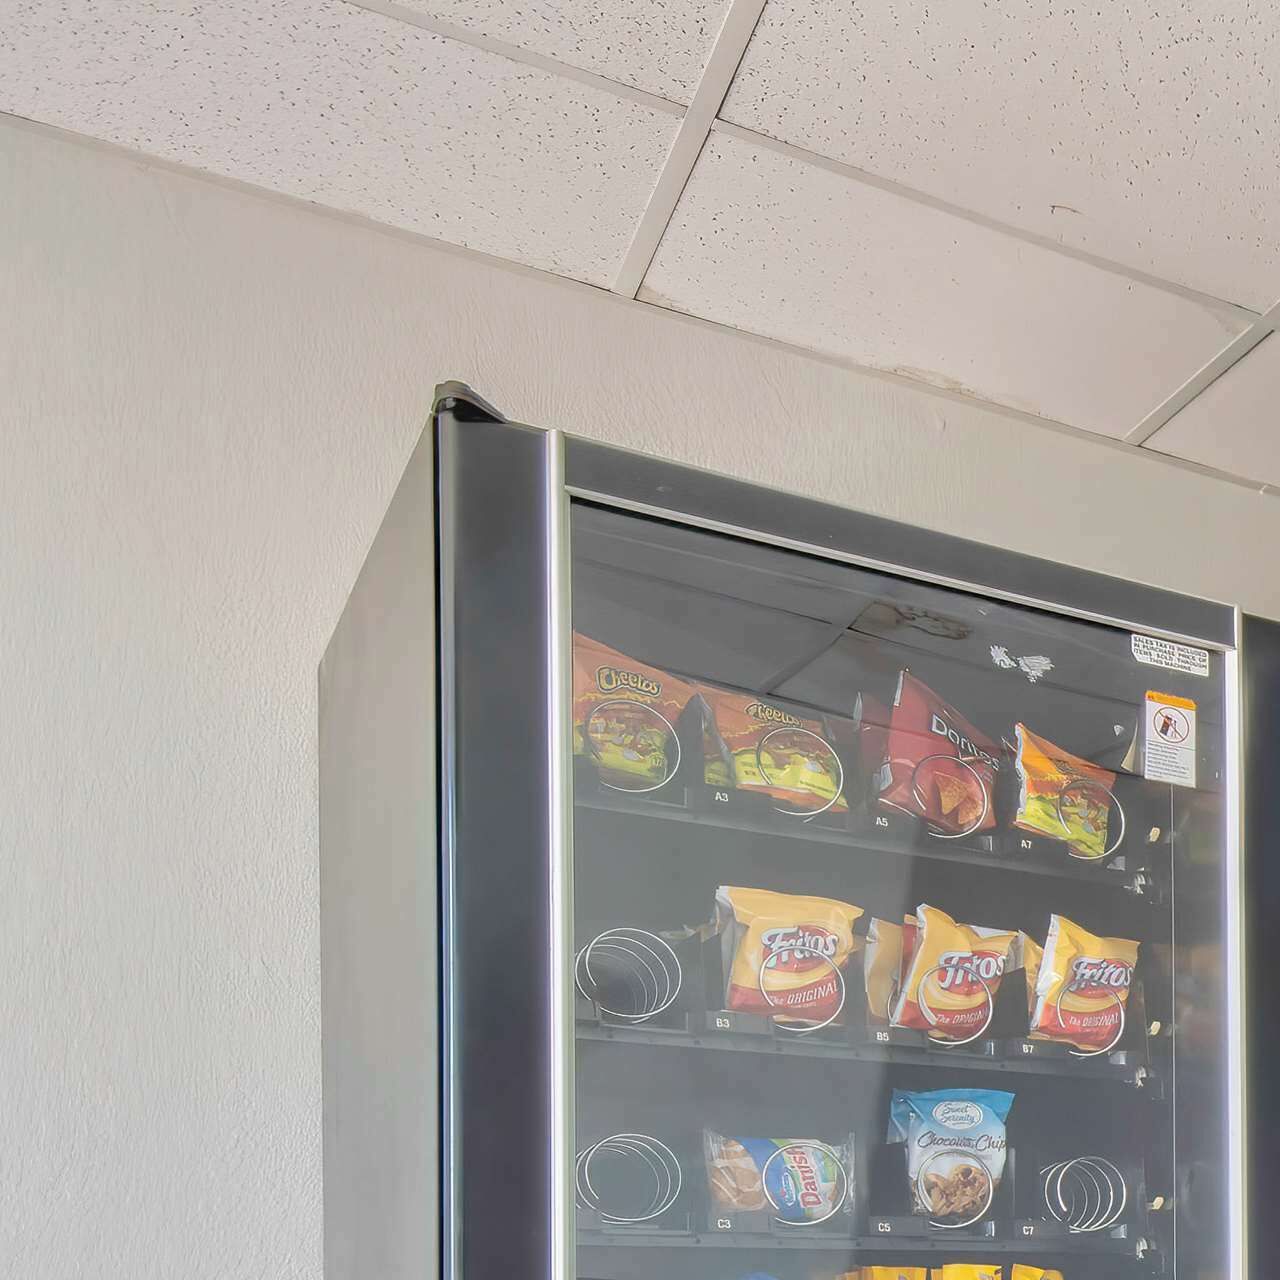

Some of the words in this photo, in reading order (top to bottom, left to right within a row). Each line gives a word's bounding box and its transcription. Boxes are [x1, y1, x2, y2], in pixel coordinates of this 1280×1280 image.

[598, 667, 660, 696] Cheetos
[931, 713, 1000, 771] Doritos
[715, 791, 729, 802] A3
[875, 816, 888, 827] A5
[1021, 839, 1032, 849] A7
[761, 926, 839, 968] Fritos
[939, 951, 1006, 989] Fritos
[1072, 957, 1134, 992] Fritos
[787, 981, 839, 1005] ORIGINAL
[716, 1017, 730, 1029] B3
[1082, 1012, 1120, 1027] ORIGINAL
[876, 1031, 890, 1042] B5
[1022, 1044, 1034, 1054] B7
[942, 1103, 970, 1116] Sweet
[784, 1149, 822, 1208] Danish
[718, 1219, 731, 1229] C3
[878, 1222, 891, 1232] C5
[1022, 1226, 1034, 1236] C7
